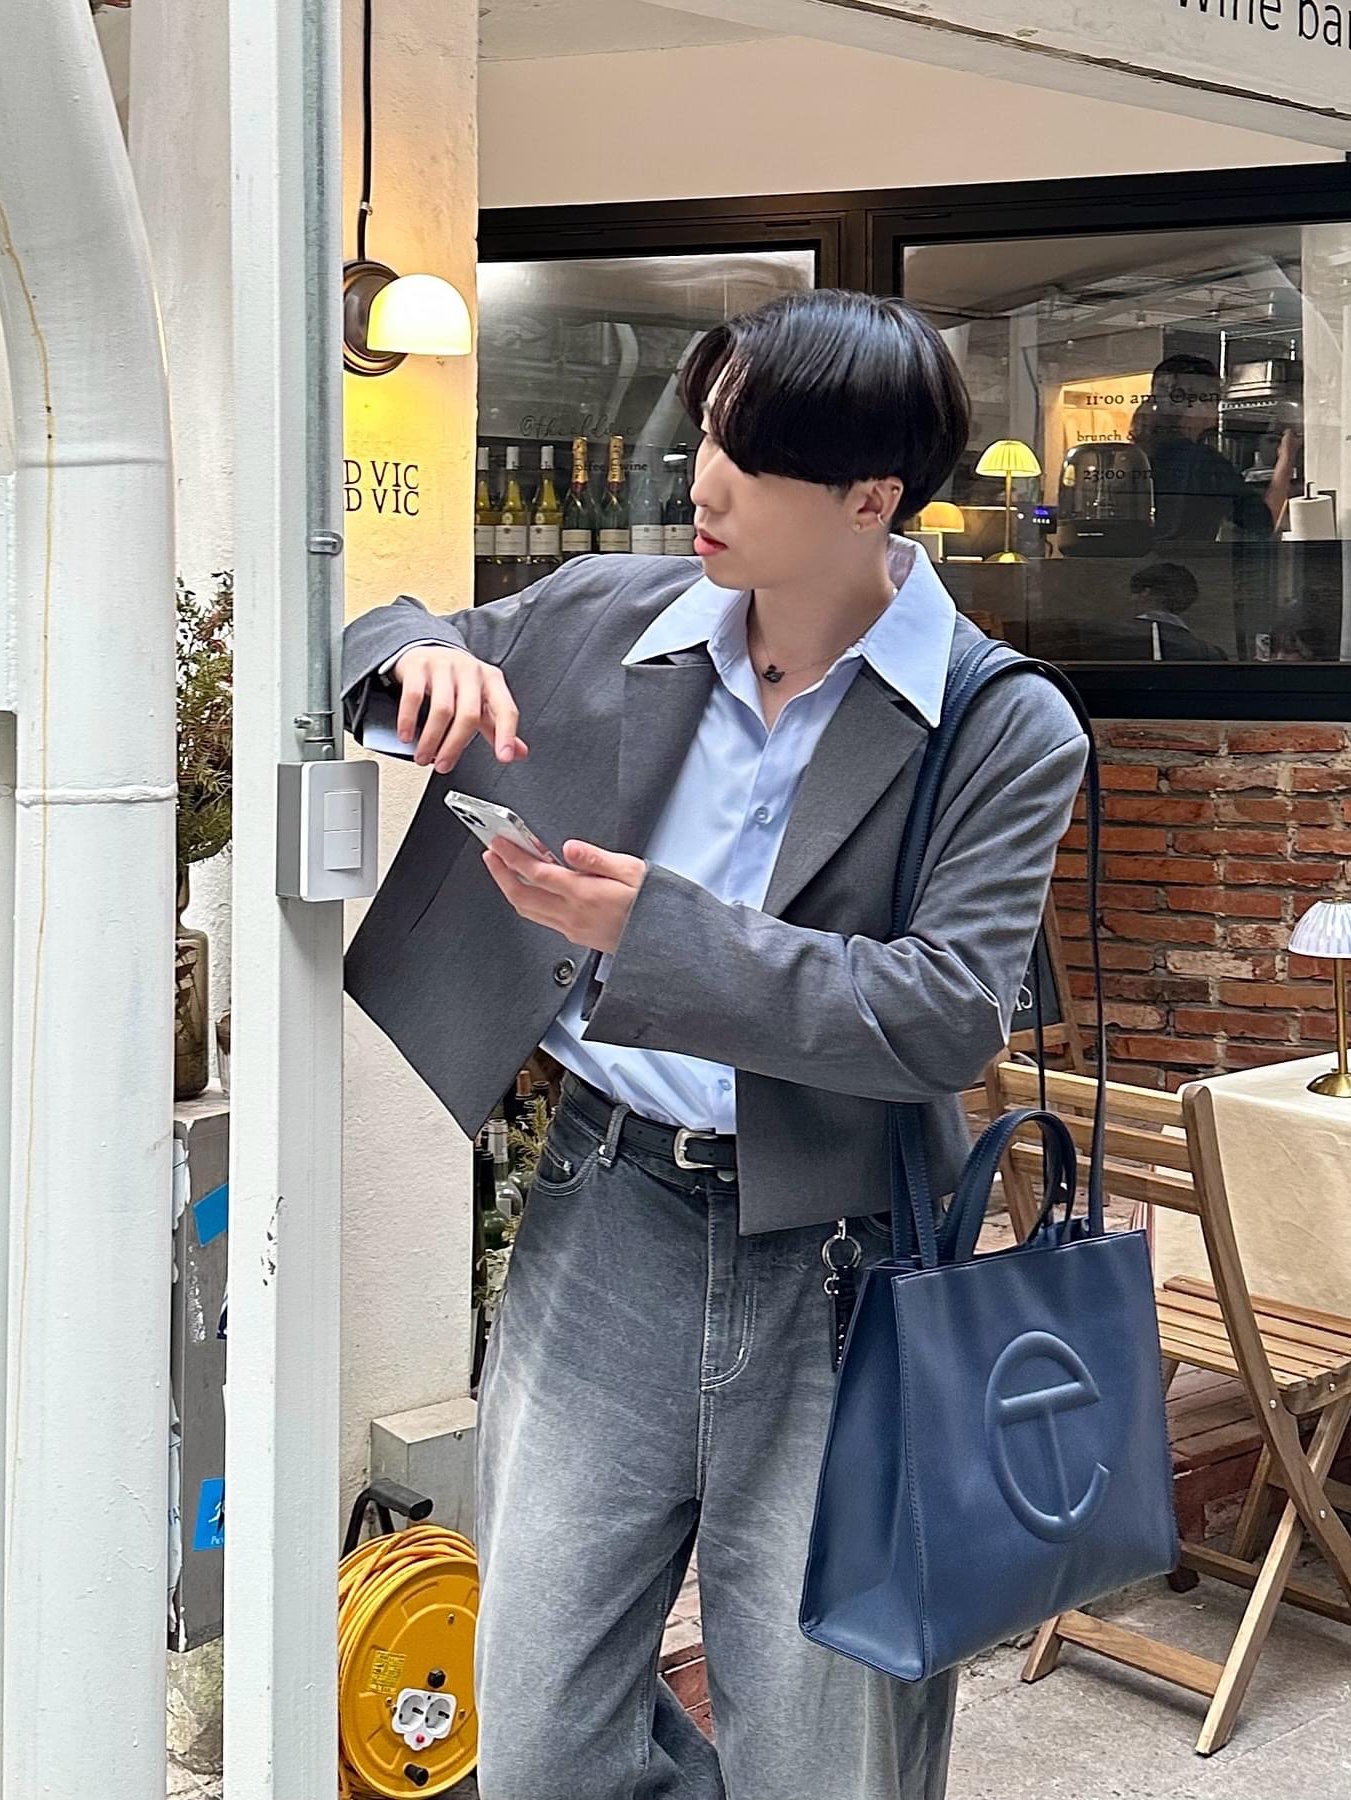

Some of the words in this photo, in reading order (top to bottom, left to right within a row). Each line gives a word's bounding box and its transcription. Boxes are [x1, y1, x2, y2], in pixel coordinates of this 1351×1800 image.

[1178, 0, 1281, 31] ne
[1299, 0, 1351, 50] ba
[1077, 430, 1122, 442] brunch
[370, 460, 419, 489] VIC
[371, 488, 419, 516] VIC
